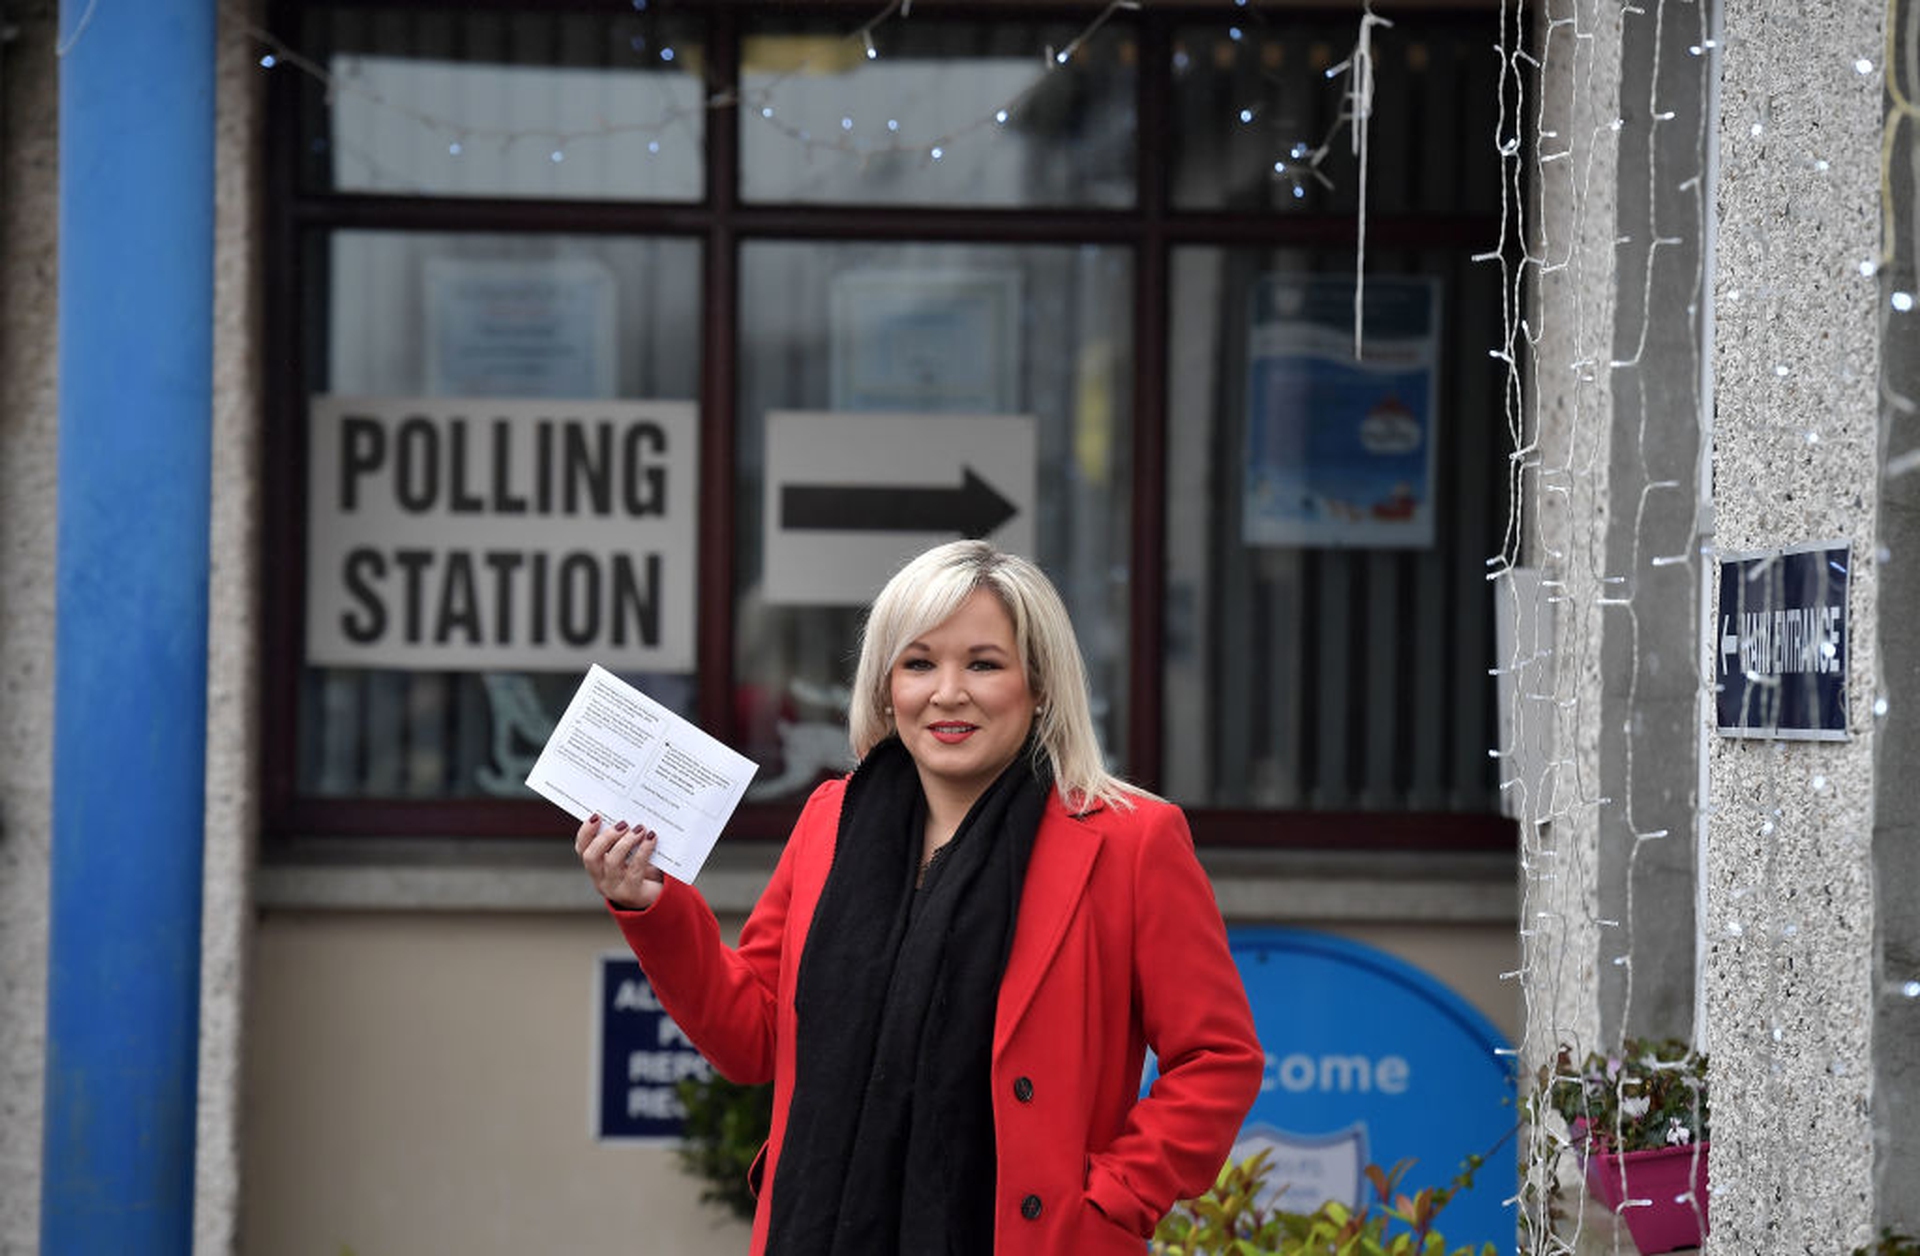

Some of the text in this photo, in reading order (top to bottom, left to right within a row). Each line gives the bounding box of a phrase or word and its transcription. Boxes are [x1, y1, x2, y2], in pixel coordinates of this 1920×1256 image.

[339, 417, 668, 518] POLLING
[340, 546, 661, 649] STATION
[1773, 606, 1841, 674] ENTRANCE
